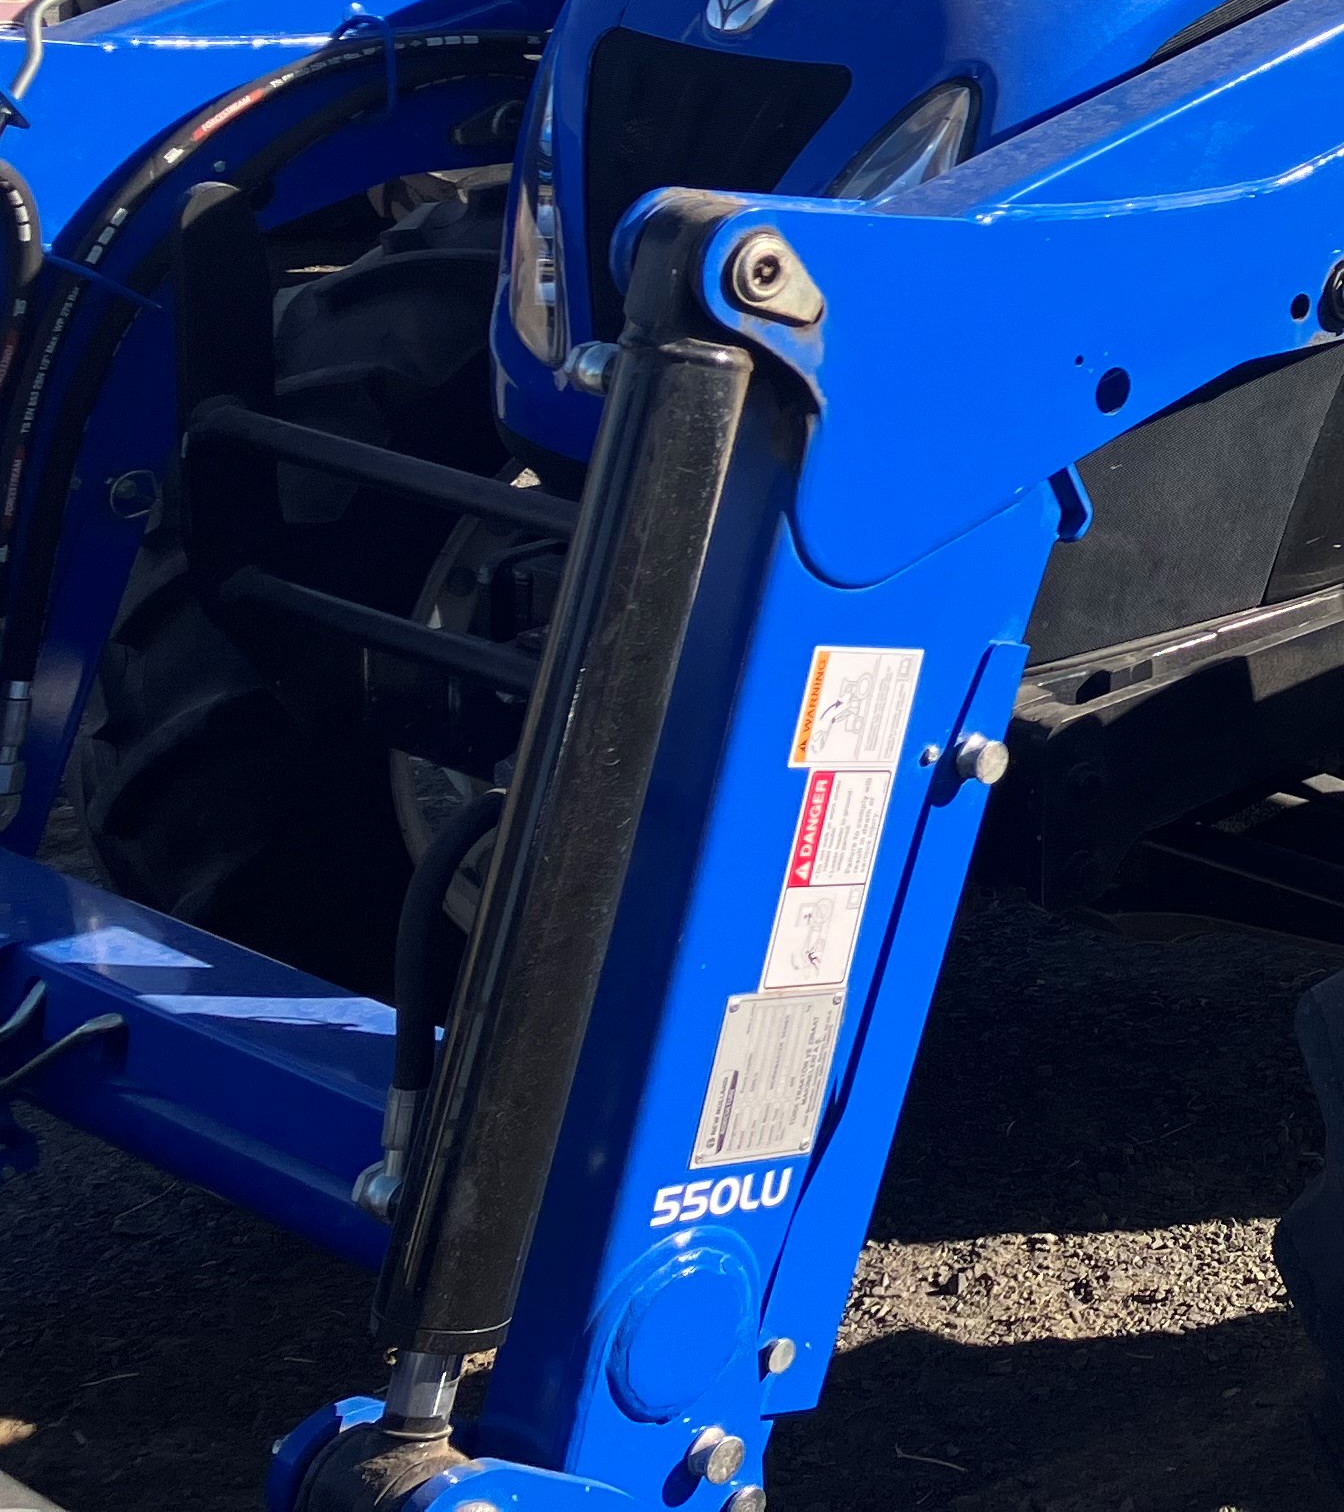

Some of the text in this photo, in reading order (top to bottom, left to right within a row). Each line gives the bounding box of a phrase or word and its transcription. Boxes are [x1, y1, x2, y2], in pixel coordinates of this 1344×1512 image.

[803, 659, 828, 733] WARNING
[799, 779, 828, 857] DANGER
[650, 1167, 792, 1228] 550LU
